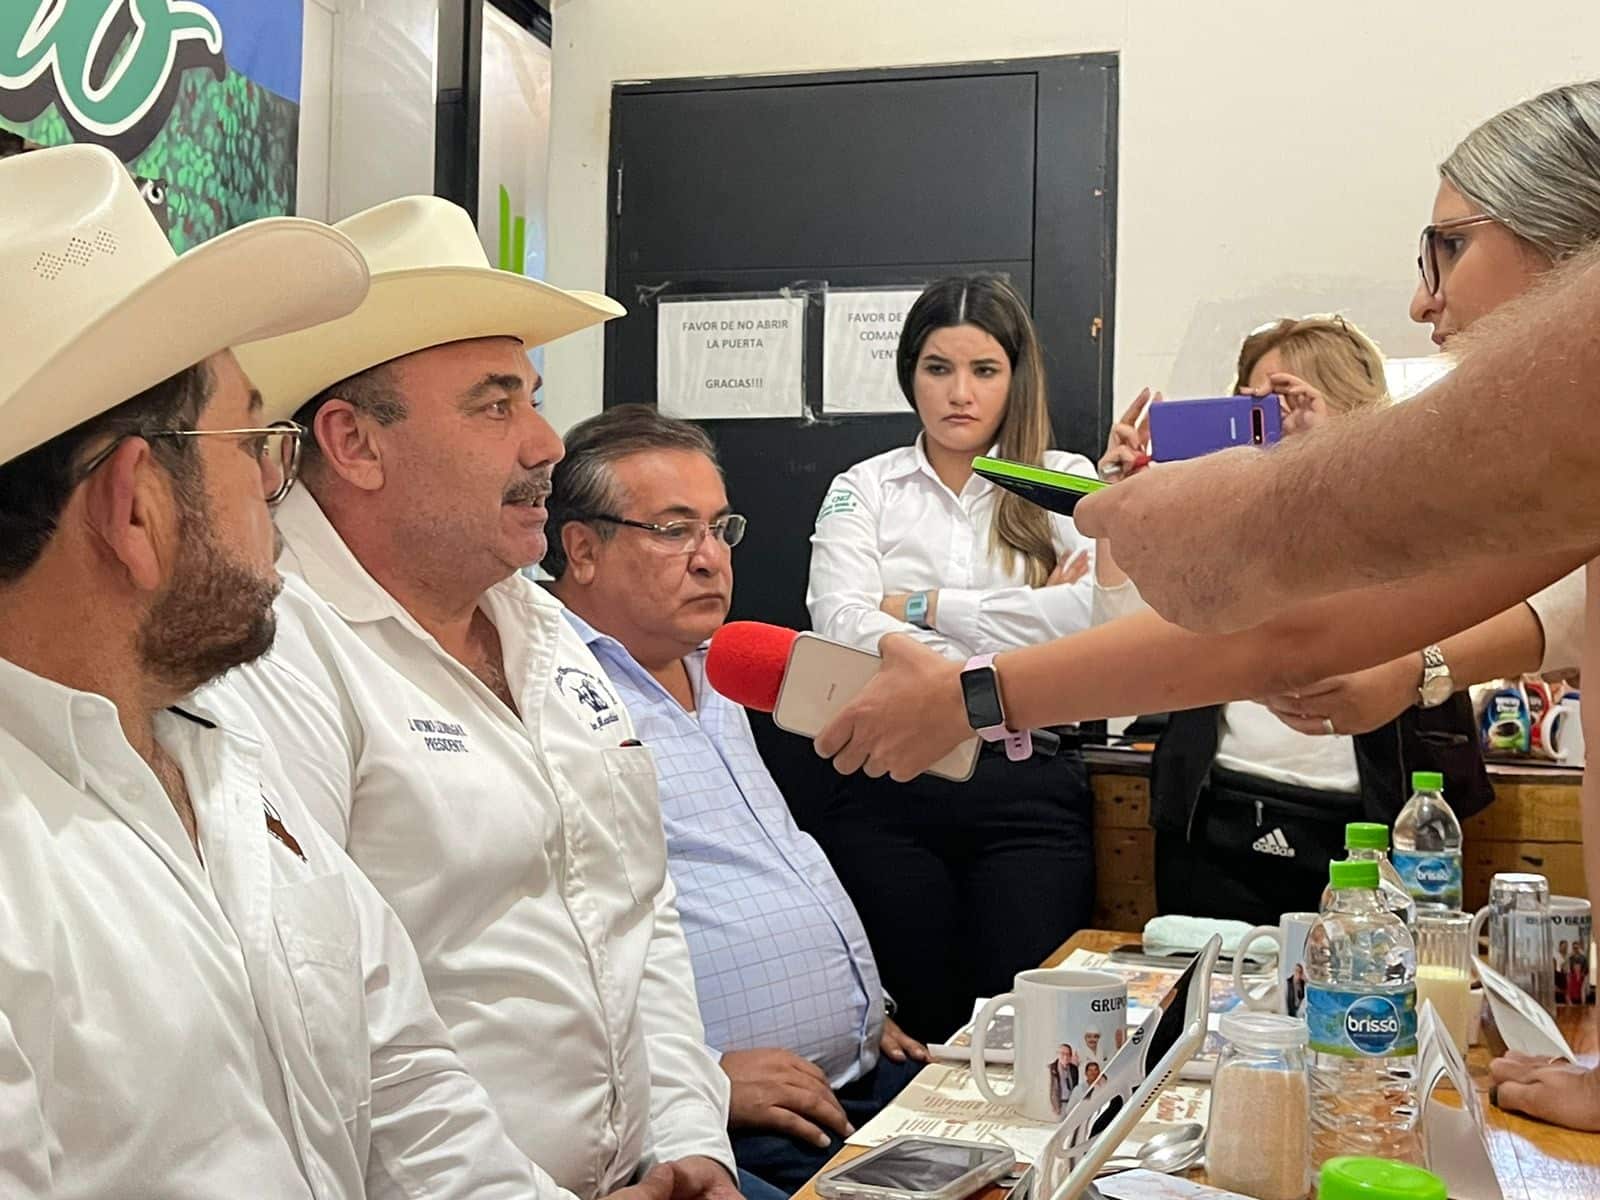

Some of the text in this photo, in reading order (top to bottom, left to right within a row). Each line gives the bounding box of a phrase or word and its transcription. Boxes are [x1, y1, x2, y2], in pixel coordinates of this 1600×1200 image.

[848, 312, 903, 323] FAVOR DE
[682, 319, 789, 331] FAVOR DE NO ABRIR
[706, 338, 764, 349] LA PUERTA
[705, 378, 764, 389] GRACIAS!!!
[1252, 841, 1296, 858] adidas
